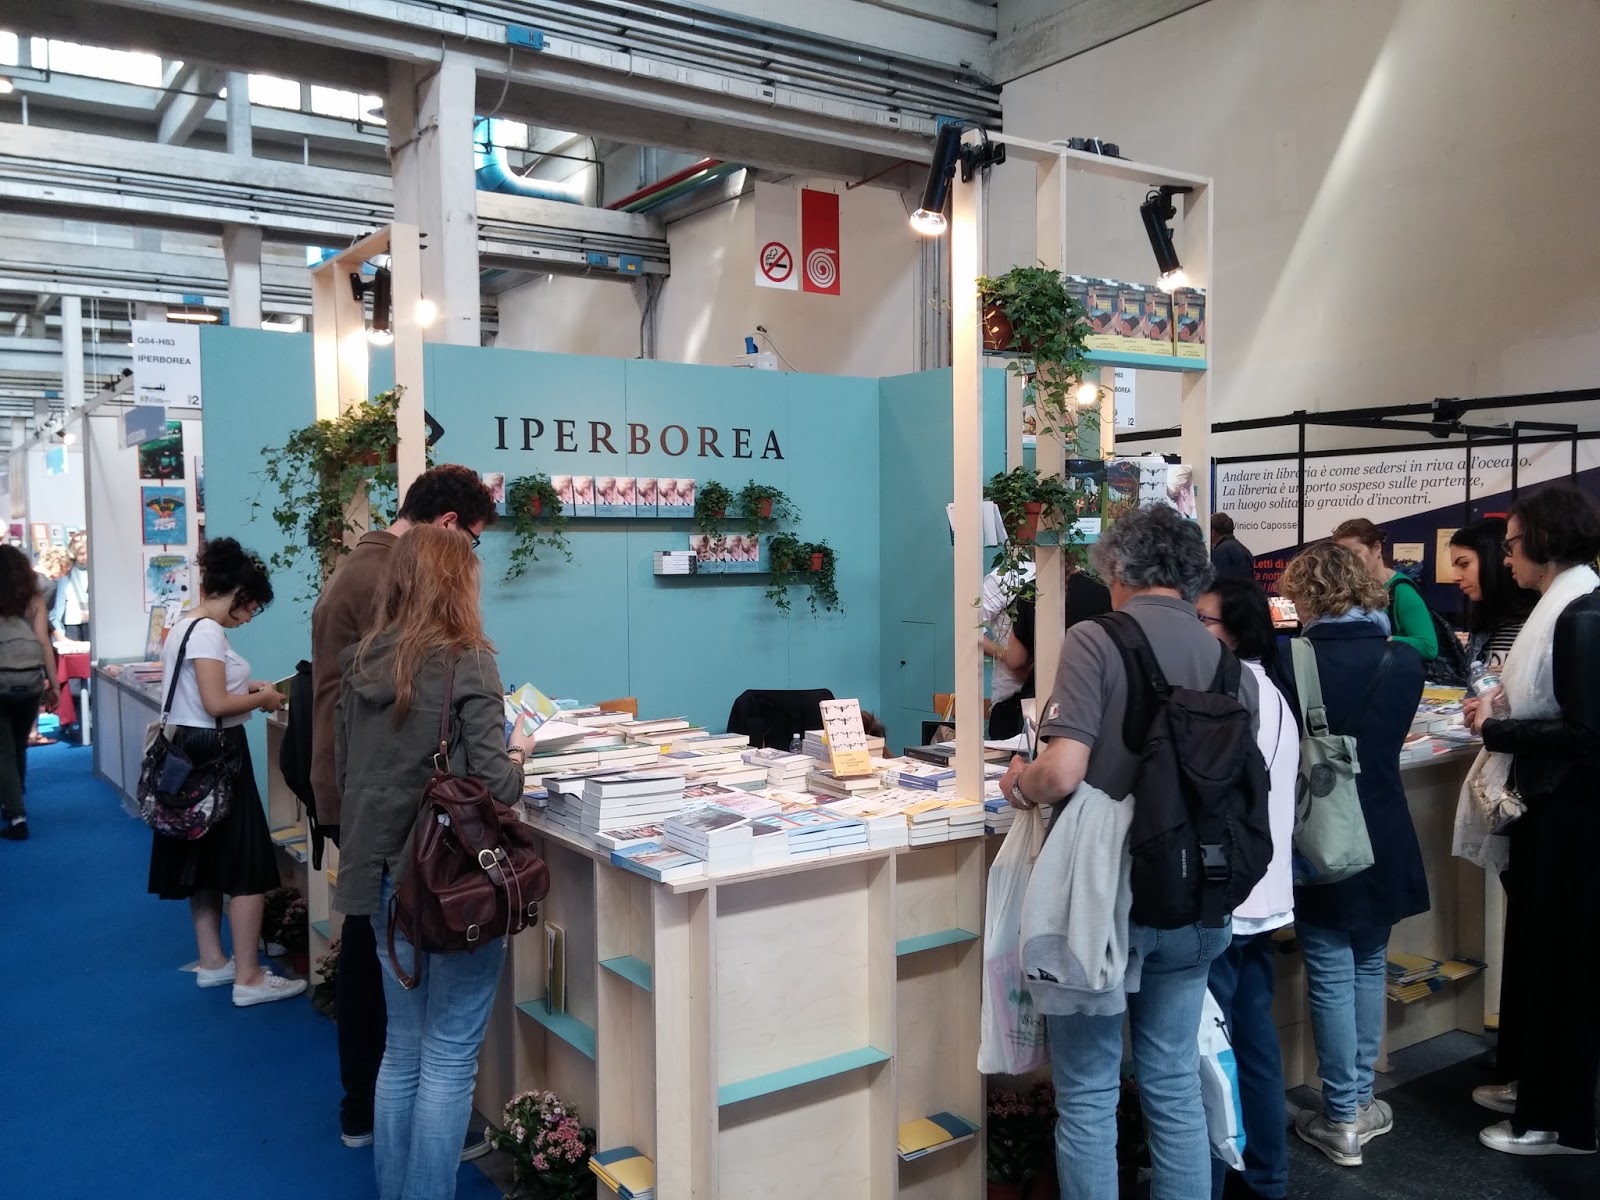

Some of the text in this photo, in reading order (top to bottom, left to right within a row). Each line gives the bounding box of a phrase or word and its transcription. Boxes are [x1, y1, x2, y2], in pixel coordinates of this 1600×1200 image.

[138, 354, 191, 365] IPERBOREA
[494, 416, 785, 460] IPERBOREA
[1222, 469, 1261, 483] Andare
[1263, 468, 1274, 480] in
[1320, 465, 1328, 478] è
[1329, 466, 1360, 477] come
[1363, 460, 1407, 474] sedersi
[1410, 459, 1423, 472] in
[1426, 458, 1453, 471] riva
[1457, 456, 1532, 471] al'oceao.
[1222, 485, 1236, 497] La
[1238, 483, 1277, 496] libreria
[1279, 483, 1286, 494] è
[1304, 481, 1336, 496] porto
[1339, 480, 1385, 494] sospeso
[1388, 475, 1418, 489] sulle
[1222, 501, 1235, 510] un
[1237, 498, 1267, 512] luogo
[1268, 497, 1315, 510] solitaio
[1317, 493, 1364, 510] gravido
[1260, 520, 1298, 532] Caposse
[1253, 559, 1273, 569] Letti
[1275, 559, 1284, 569] di
[1262, 572, 1281, 581] nott
